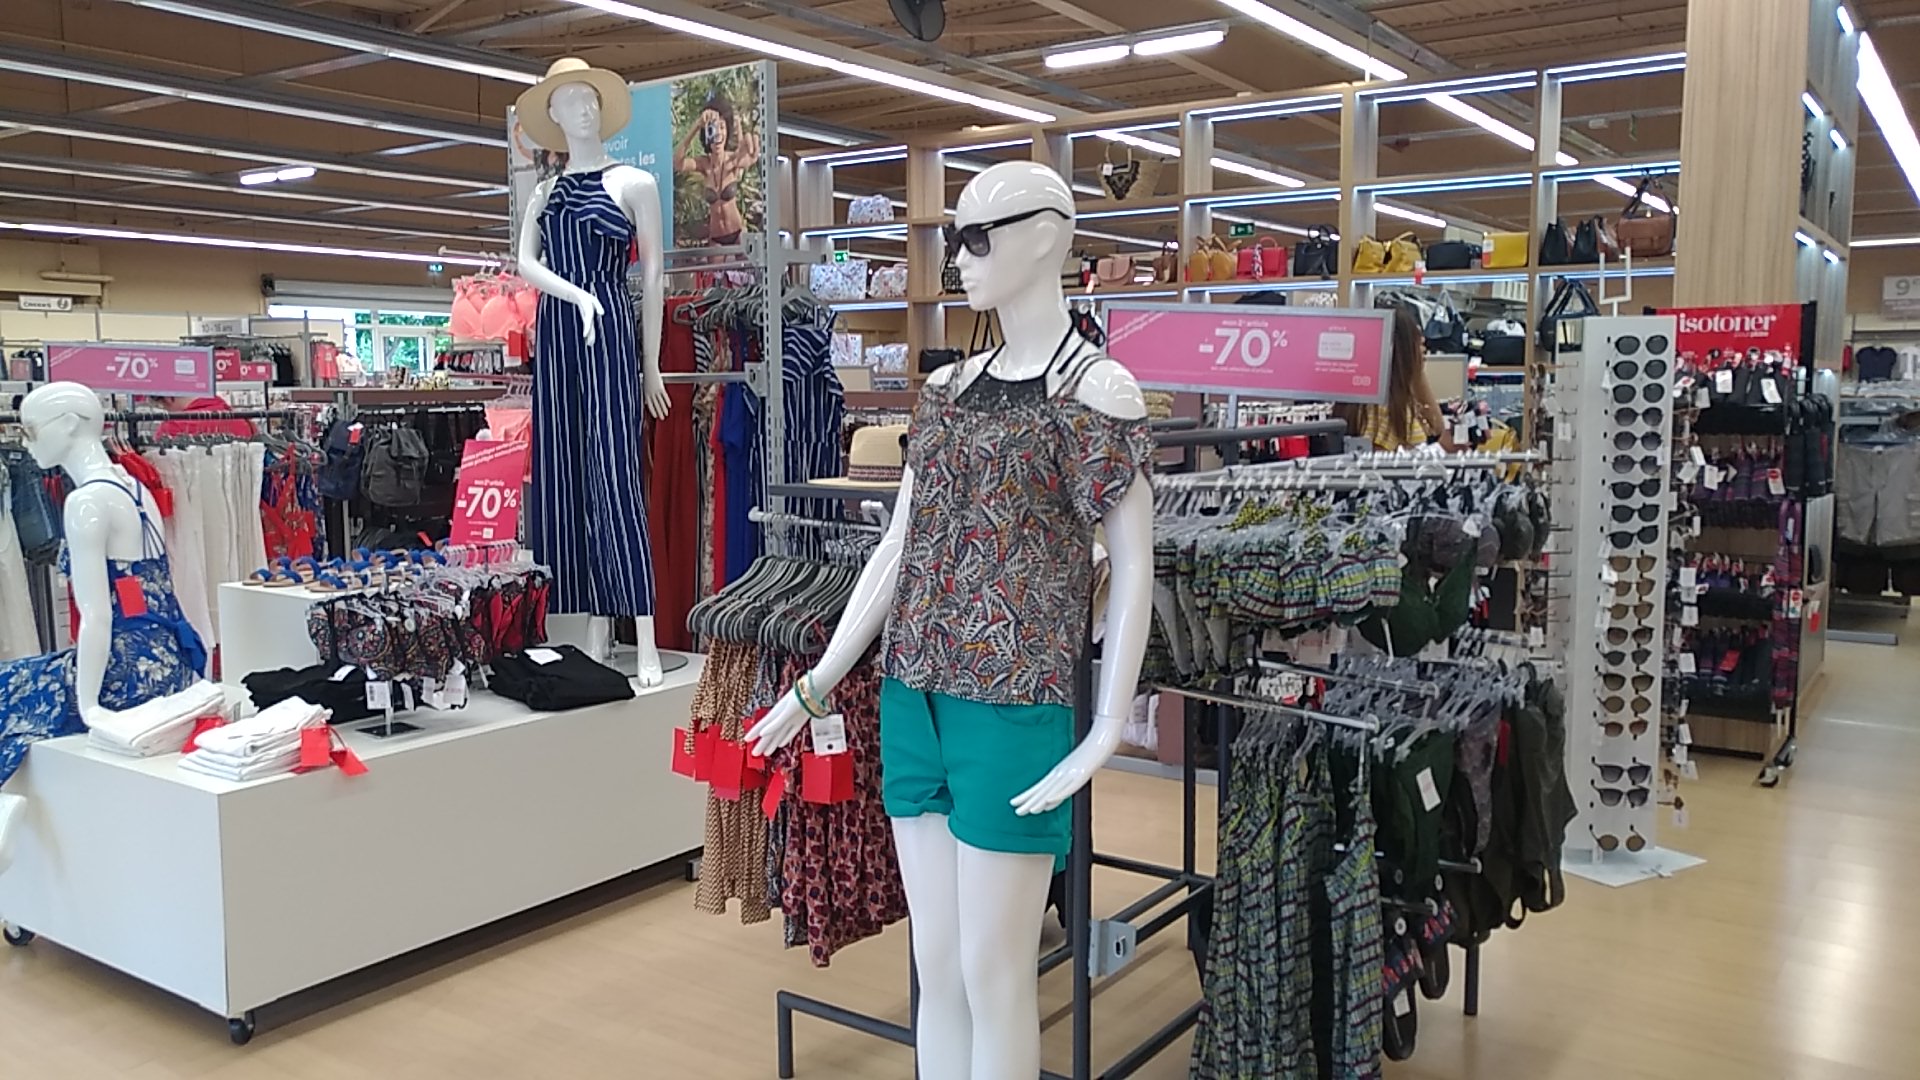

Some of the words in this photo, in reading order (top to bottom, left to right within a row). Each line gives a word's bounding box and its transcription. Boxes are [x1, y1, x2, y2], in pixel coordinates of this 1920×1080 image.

[639, 151, 656, 166] les
[1679, 312, 1777, 333] isotoner
[1199, 327, 1288, 368] -70%
[106, 356, 158, 379] -70%
[456, 486, 517, 519] -70%
